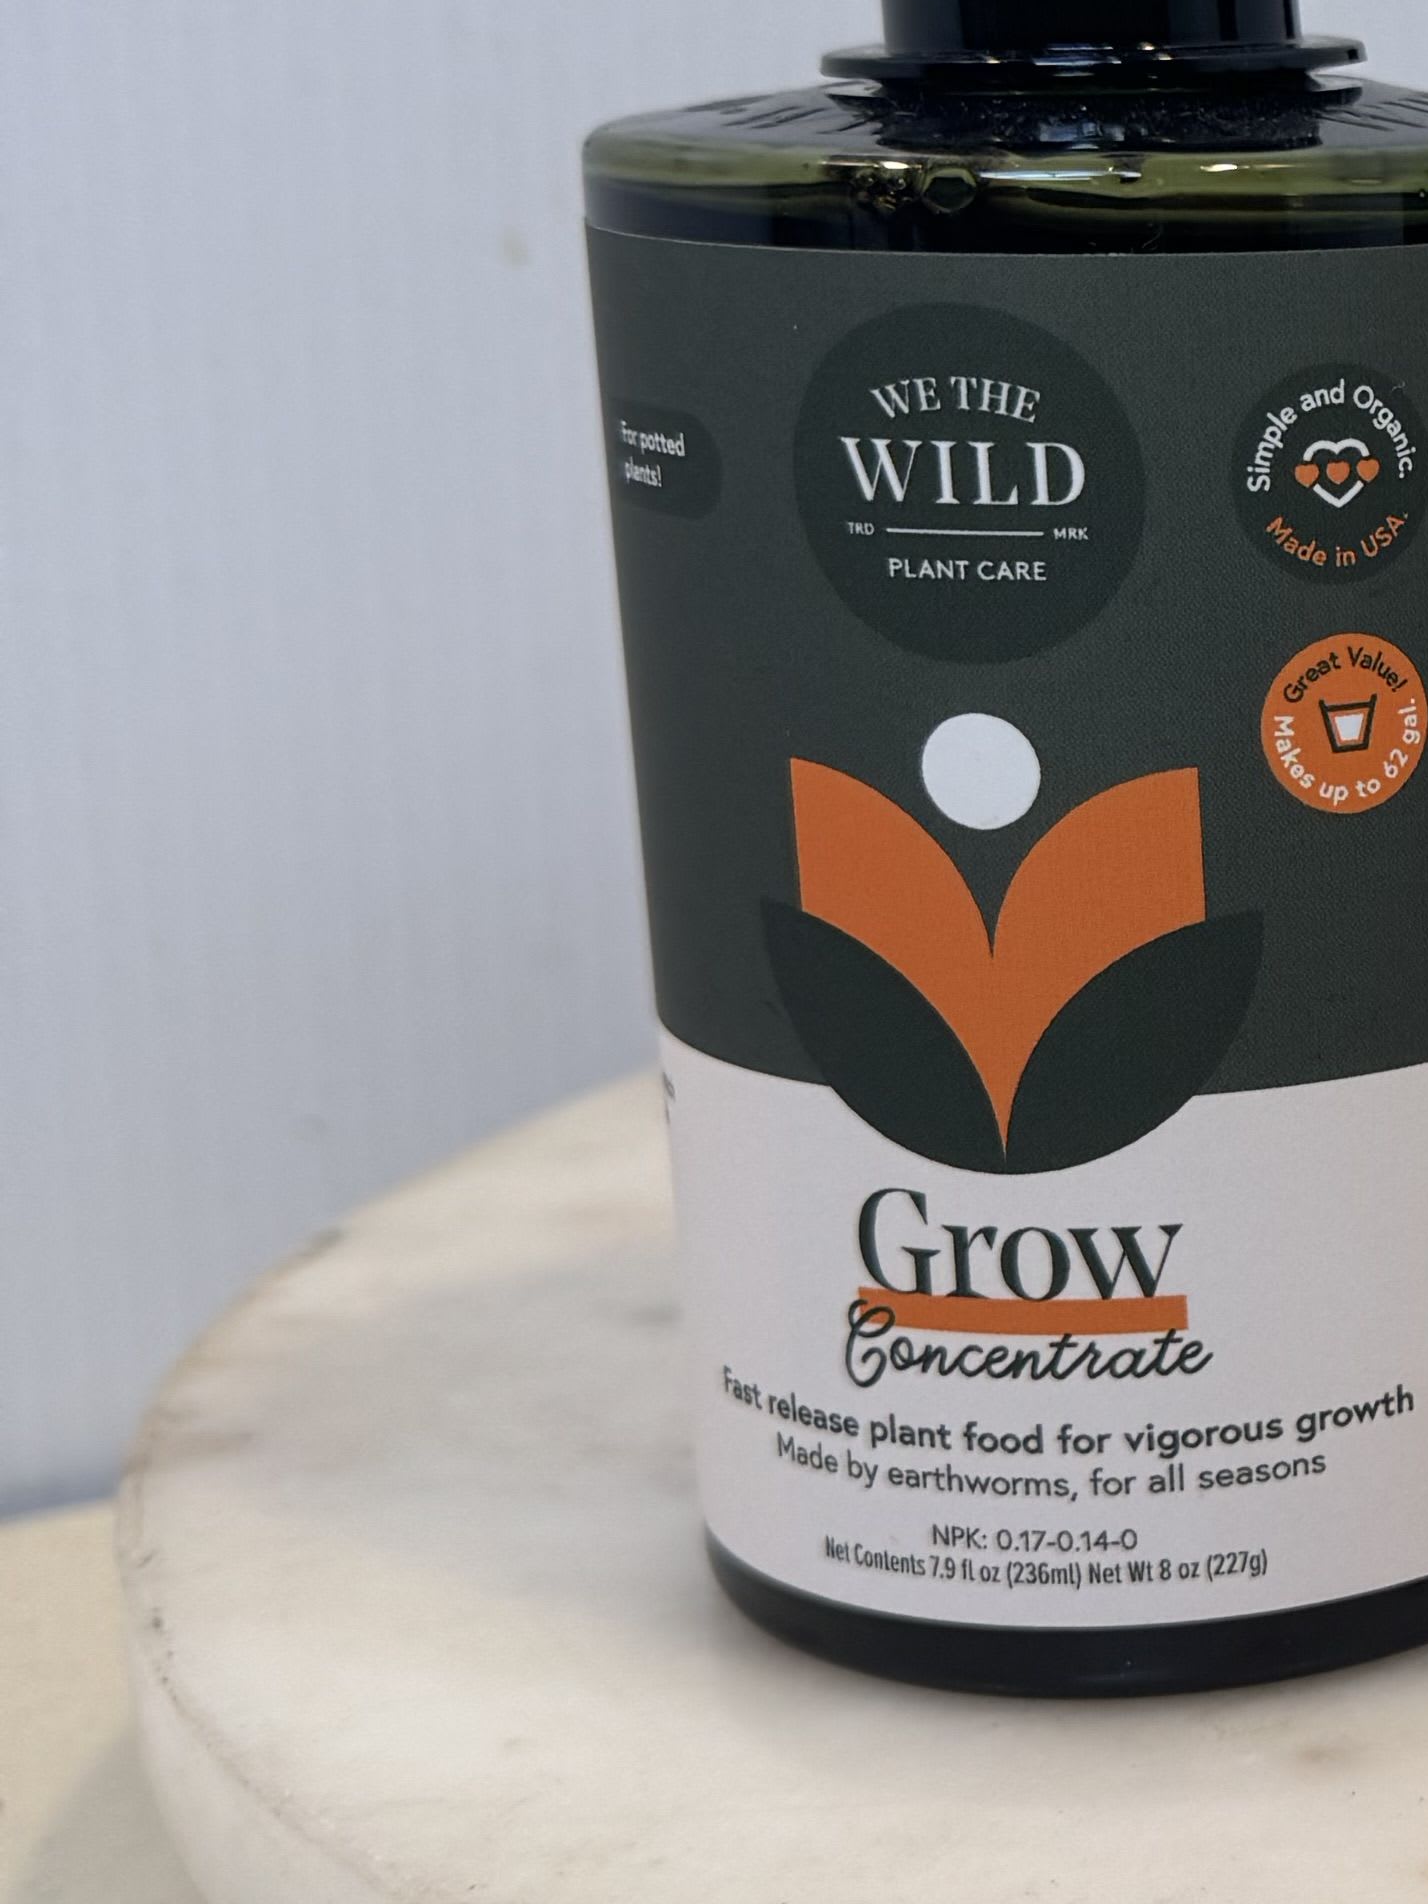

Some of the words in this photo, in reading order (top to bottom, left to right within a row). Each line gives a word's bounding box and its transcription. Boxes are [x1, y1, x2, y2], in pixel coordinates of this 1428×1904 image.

[870, 377, 941, 419] WE
[949, 376, 1041, 423] THE
[640, 431, 686, 457] potted
[1247, 406, 1297, 492] Simple
[1300, 379, 1346, 411] and
[625, 456, 662, 487] plants!
[840, 436, 1085, 506] WILD
[848, 522, 875, 536] TRD
[1053, 528, 1088, 541] MRK
[1265, 515, 1327, 567] Made
[1335, 548, 1356, 567] in
[888, 558, 969, 580] PLANT
[977, 560, 1047, 582] CARE
[1283, 652, 1340, 703] Great
[1347, 647, 1408, 692] Value!
[1274, 716, 1312, 790] Makes
[1319, 783, 1349, 805] up
[1356, 778, 1381, 797] to
[1383, 748, 1409, 781] 62
[858, 1187, 1183, 1302] Grow
[845, 1299, 1214, 1388] Concentrate
[723, 1365, 763, 1410] Fast
[768, 1392, 860, 1437] release
[870, 1412, 952, 1451] plant
[964, 1423, 1043, 1455] food
[1057, 1423, 1111, 1455] for
[1124, 1417, 1283, 1458] vigorous
[1296, 1383, 1414, 1442] growth
[777, 1431, 838, 1474] Made
[846, 1446, 878, 1489] by
[888, 1462, 1078, 1502] earthworms,
[1090, 1467, 1137, 1496] for
[1148, 1462, 1184, 1494] all
[1199, 1451, 1326, 1489] seasons
[825, 1535, 852, 1563] Net
[854, 1543, 926, 1578] Contents
[929, 1557, 957, 1580] 7.9
[961, 1560, 977, 1581] fl
[979, 1566, 1000, 1583] oz
[1007, 1560, 1082, 1590] (236ml)
[1089, 1561, 1123, 1585] Net
[1128, 1560, 1154, 1582] Wt
[1159, 1560, 1173, 1581] 8
[1178, 1561, 1200, 1578] oz
[1206, 1549, 1268, 1582] (227g)
[932, 1523, 988, 1552] NPK:
[997, 1528, 1138, 1553] 0.17-0.14-0
